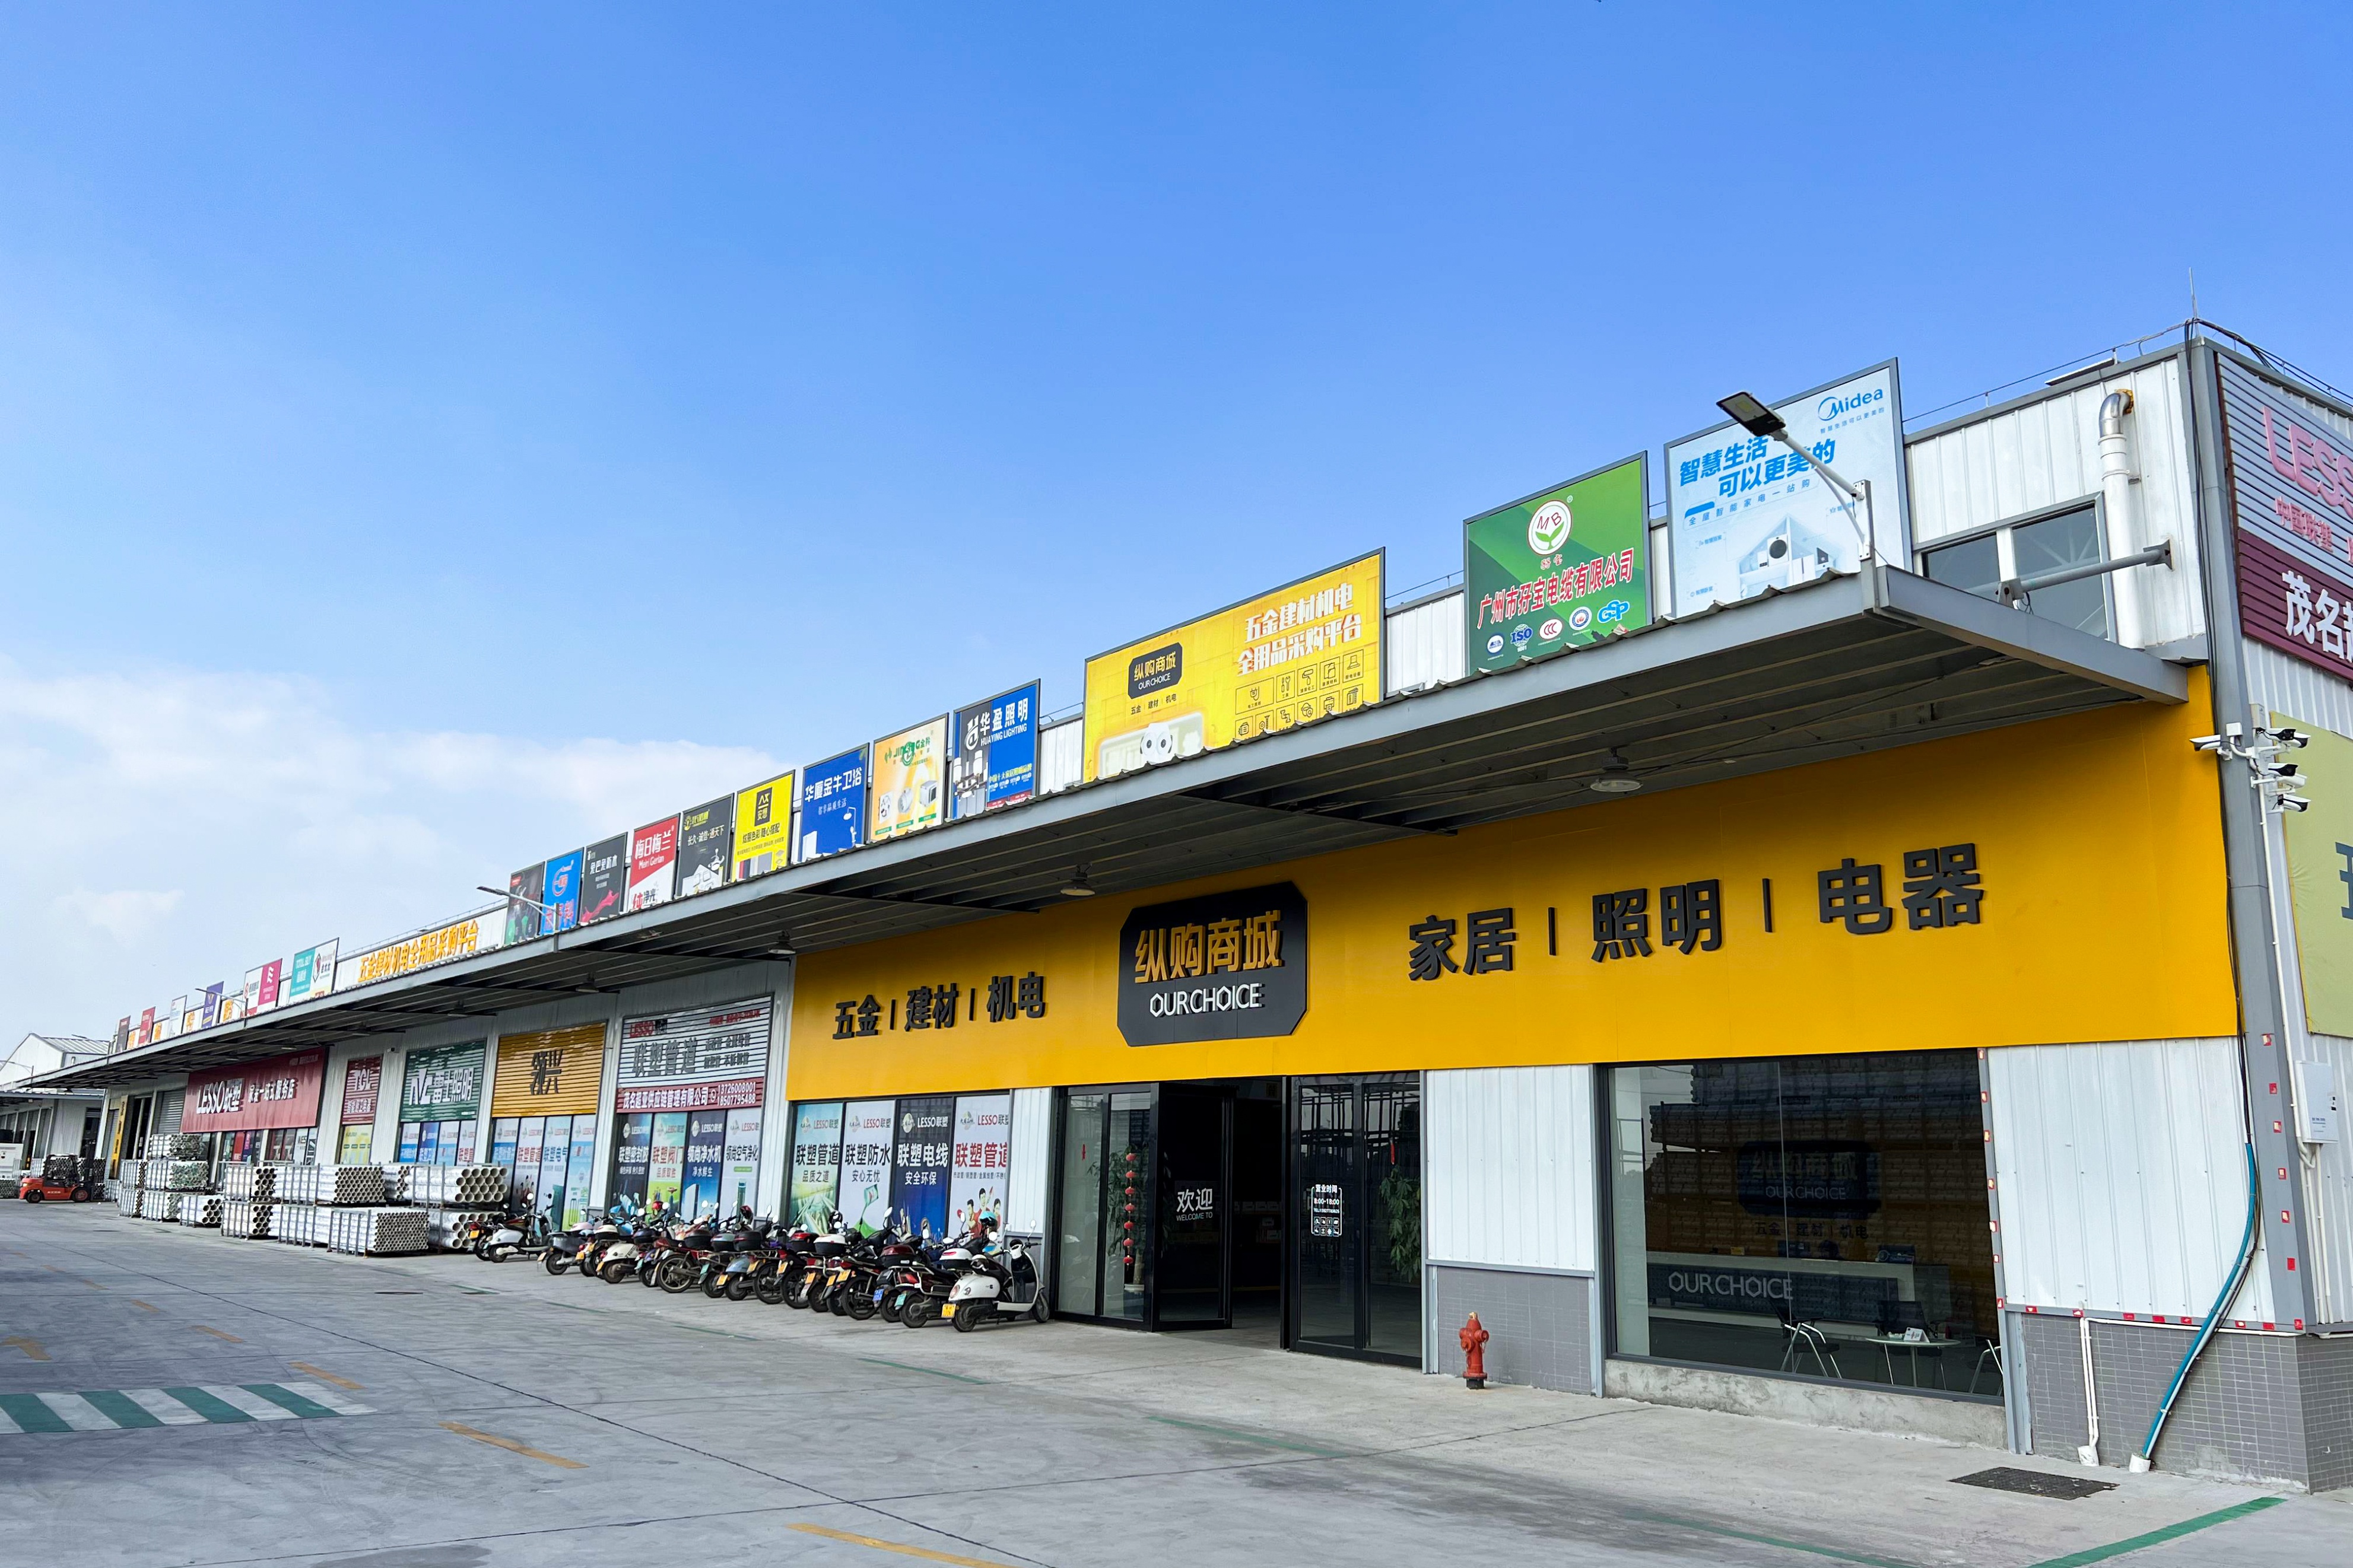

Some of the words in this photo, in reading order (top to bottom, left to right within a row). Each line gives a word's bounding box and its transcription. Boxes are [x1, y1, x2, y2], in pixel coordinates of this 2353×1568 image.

[1818, 388, 1883, 421] Midea
[1820, 407, 1885, 434] 智慧生活可以更美的
[1679, 435, 1768, 486] 智慧生活
[1688, 479, 1811, 526] 全屋智能家电一站购
[2275, 496, 2333, 553] 中国联塑
[1477, 548, 1634, 629] 广州市孖宝电缆有限公司
[1244, 582, 1354, 643] 五金建材机电
[1236, 612, 1363, 676] 全用品采购平台
[1510, 627, 1533, 644] ISO
[1133, 650, 1176, 682] 纵购商城
[980, 698, 1028, 736] 华盈照明
[1131, 704, 1141, 715] 五金
[1148, 698, 1159, 709] 建材
[1166, 692, 1177, 704] 机电
[980, 730, 1003, 746] HUAYING
[1004, 723, 1027, 739] LIGHTING
[1408, 907, 1517, 981] 家居
[1592, 879, 1723, 963] 照明
[1817, 842, 1984, 934] 电器
[358, 920, 479, 982] 五金建材机电全用品采购平台
[1135, 909, 1285, 984] 纵购商城
[833, 994, 882, 1041] 五金
[905, 982, 960, 1032] 建材
[986, 971, 1047, 1023] 机电
[1149, 982, 1265, 1018] OURCHOICE
[632, 1037, 698, 1077] 联塑管道
[354, 1068, 373, 1092] TCL
[433, 1067, 474, 1103] 雷士照明
[795, 1143, 840, 1166] 联塑管道
[845, 1143, 891, 1166] 联塑防水
[897, 1143, 948, 1168] 联塑电线
[802, 1170, 830, 1182] 品质之道
[852, 1169, 881, 1182] 安心无忧
[904, 1171, 937, 1185] 安全环保
[1315, 1184, 1338, 1193] 营业时间
[1176, 1188, 1213, 1213] 欢迎
[1176, 1213, 1204, 1221] WELCOME
[1755, 1222, 1781, 1236] 五金
[1797, 1222, 1823, 1237] 建材
[1840, 1224, 1868, 1239] 机电
[1668, 1271, 1793, 1299] OURCHOICE
